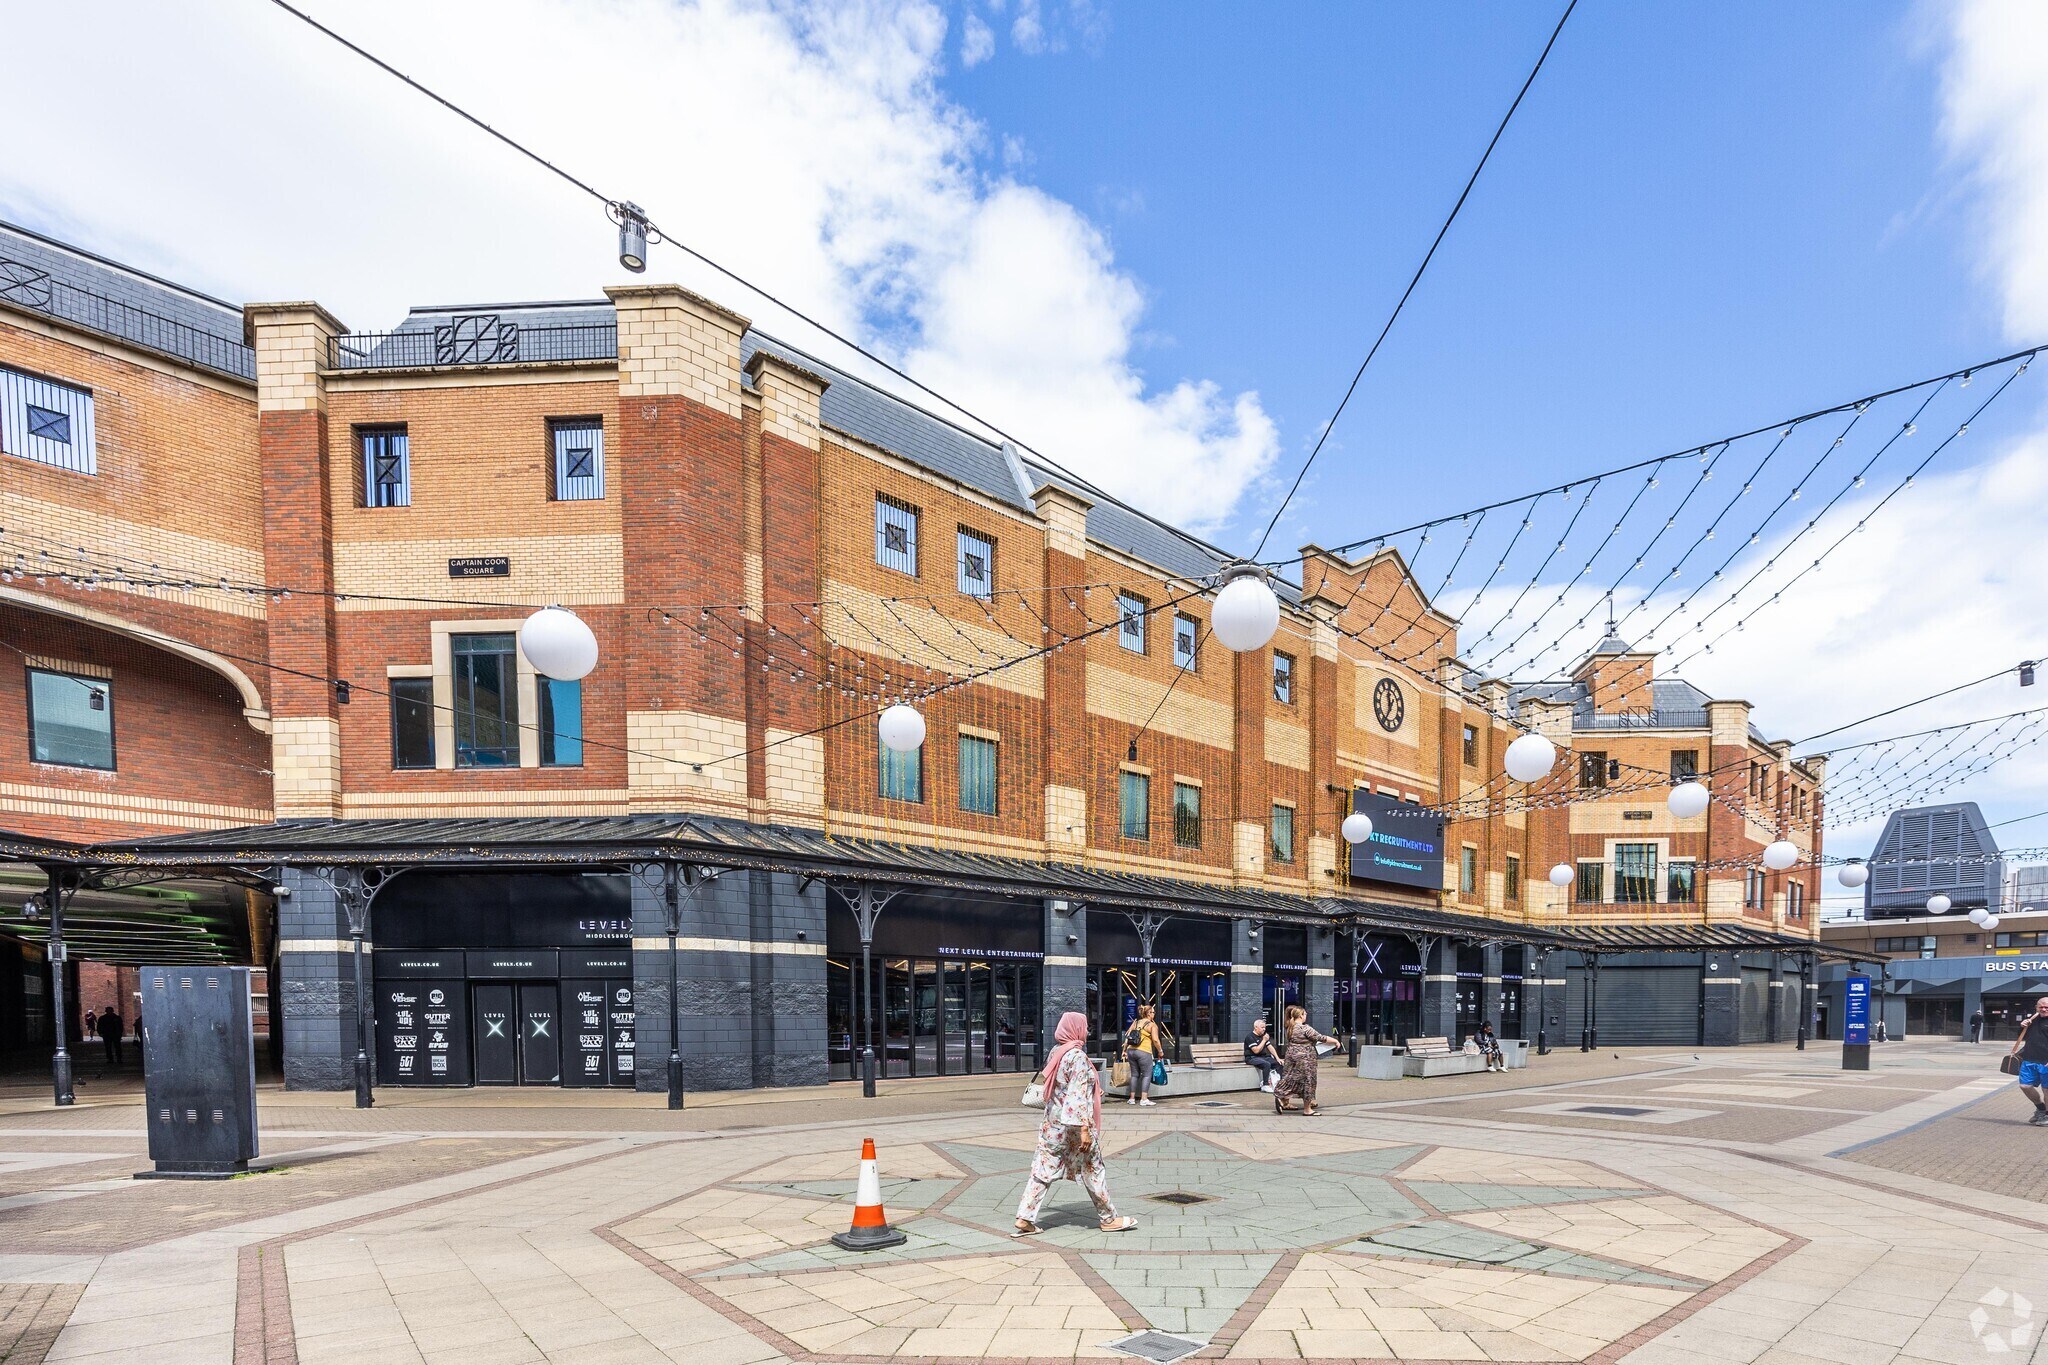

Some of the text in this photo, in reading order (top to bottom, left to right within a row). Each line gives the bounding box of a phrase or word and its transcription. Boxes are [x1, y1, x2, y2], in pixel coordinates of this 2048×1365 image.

[1380, 834, 1422, 850] RECRUITMENT
[1422, 842, 1433, 853] LTD
[987, 950, 1044, 958] ENTERTAINMENT
[1171, 958, 1212, 966] ENTERTAINMENT
[1986, 961, 2048, 972] BUS STA
[425, 1013, 450, 1021] GUTTER
